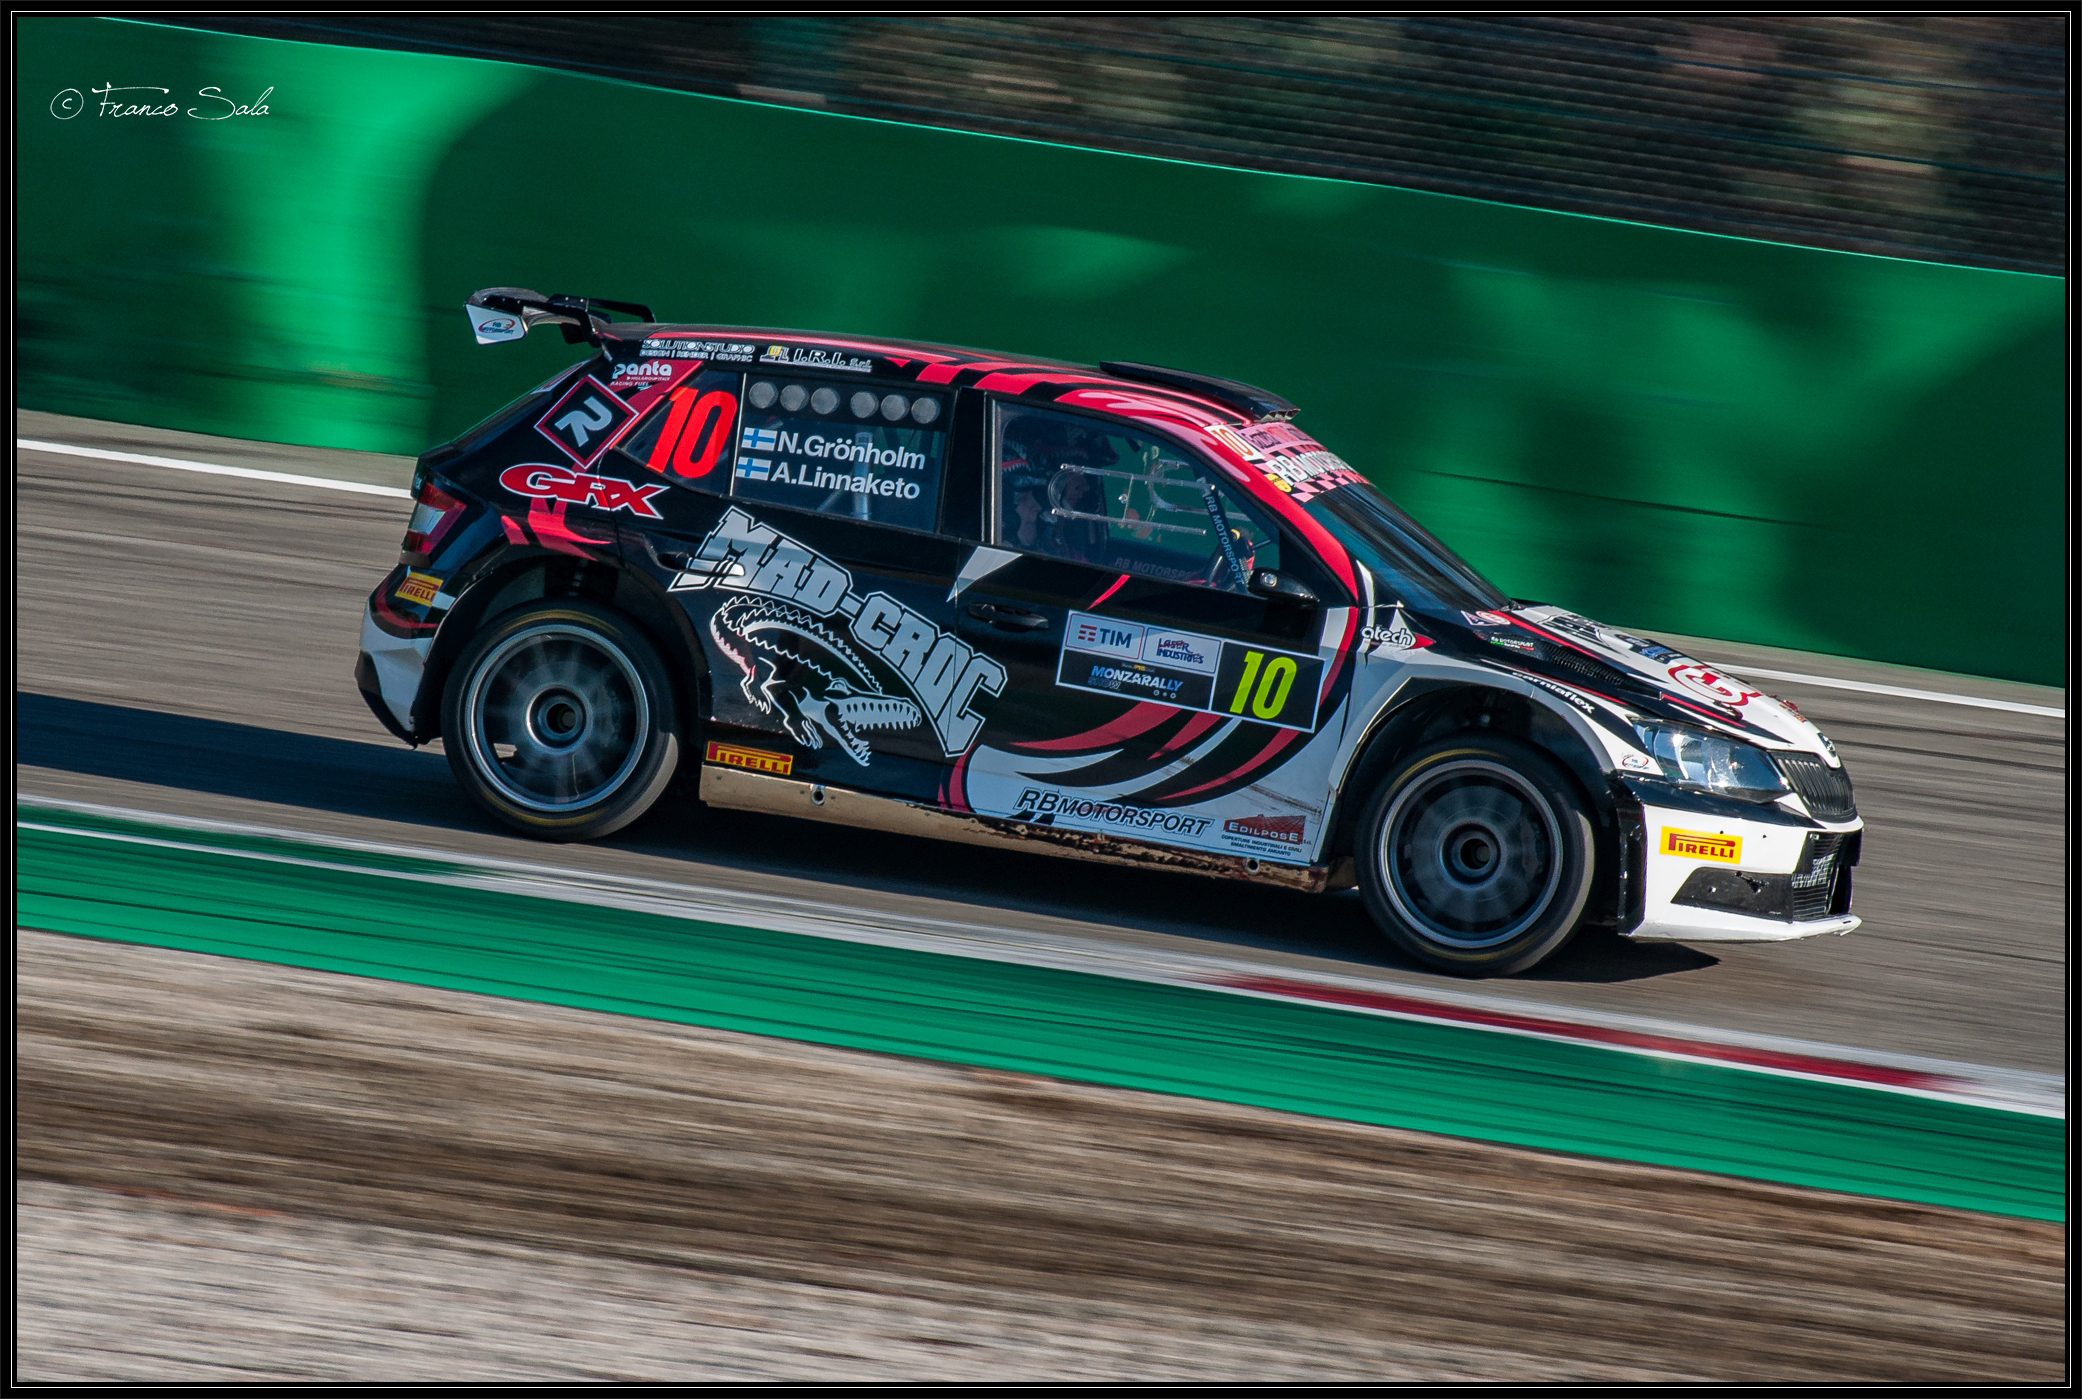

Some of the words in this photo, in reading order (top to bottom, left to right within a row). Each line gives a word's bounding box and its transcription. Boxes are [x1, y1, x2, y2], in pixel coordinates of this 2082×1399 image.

[639, 349, 670, 357] DESIGN
[676, 350, 709, 359] RENDER
[716, 352, 753, 362] GRAPHIC
[611, 361, 672, 380] panta
[646, 386, 738, 479] 10
[1211, 428, 1254, 458] 10
[777, 430, 926, 470] N.Grönholm
[499, 463, 671, 521] GRX
[771, 462, 921, 500] A.Linnaketo
[1204, 494, 1218, 513] RB
[1211, 513, 1246, 586] MOTORSPORT
[1114, 557, 1131, 570] RB
[399, 577, 440, 603] PIRELLI
[667, 505, 1008, 758] MAD-CROC
[1099, 628, 1133, 649] TIM
[1360, 624, 1413, 646] atech
[1156, 648, 1205, 665] INDUSTRIES
[1090, 665, 1184, 692] MONZARALLY
[1229, 650, 1298, 719] 10
[1511, 671, 1596, 714] carniaflex
[707, 742, 793, 775] PIRELLI
[1221, 834, 1251, 844] COPERTURE
[1251, 838, 1283, 850] INDUSTRIALI
[1230, 841, 1267, 853] SMALTIMENTO
[1267, 847, 1291, 857] AMIANTO
[1668, 832, 1736, 859] PIRELLI
